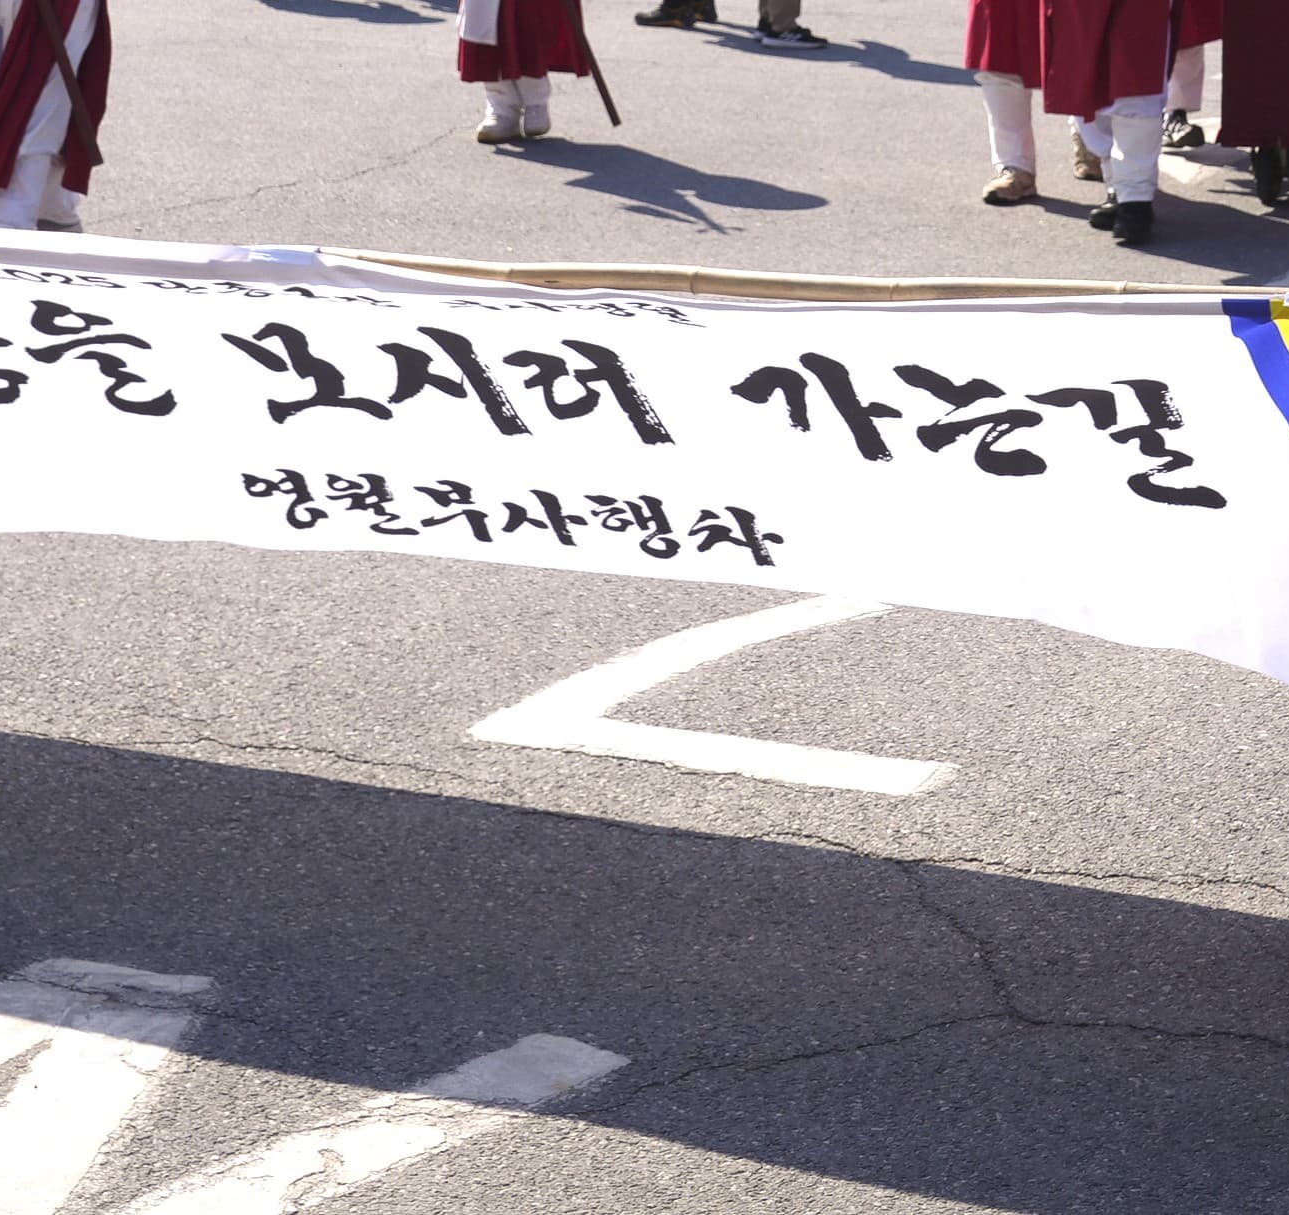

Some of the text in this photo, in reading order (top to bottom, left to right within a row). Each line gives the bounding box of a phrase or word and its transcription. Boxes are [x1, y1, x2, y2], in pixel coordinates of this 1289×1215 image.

[221, 321, 677, 447] 모시러
[729, 351, 1228, 510] 가는길
[242, 468, 784, 567] 영월부사행차
